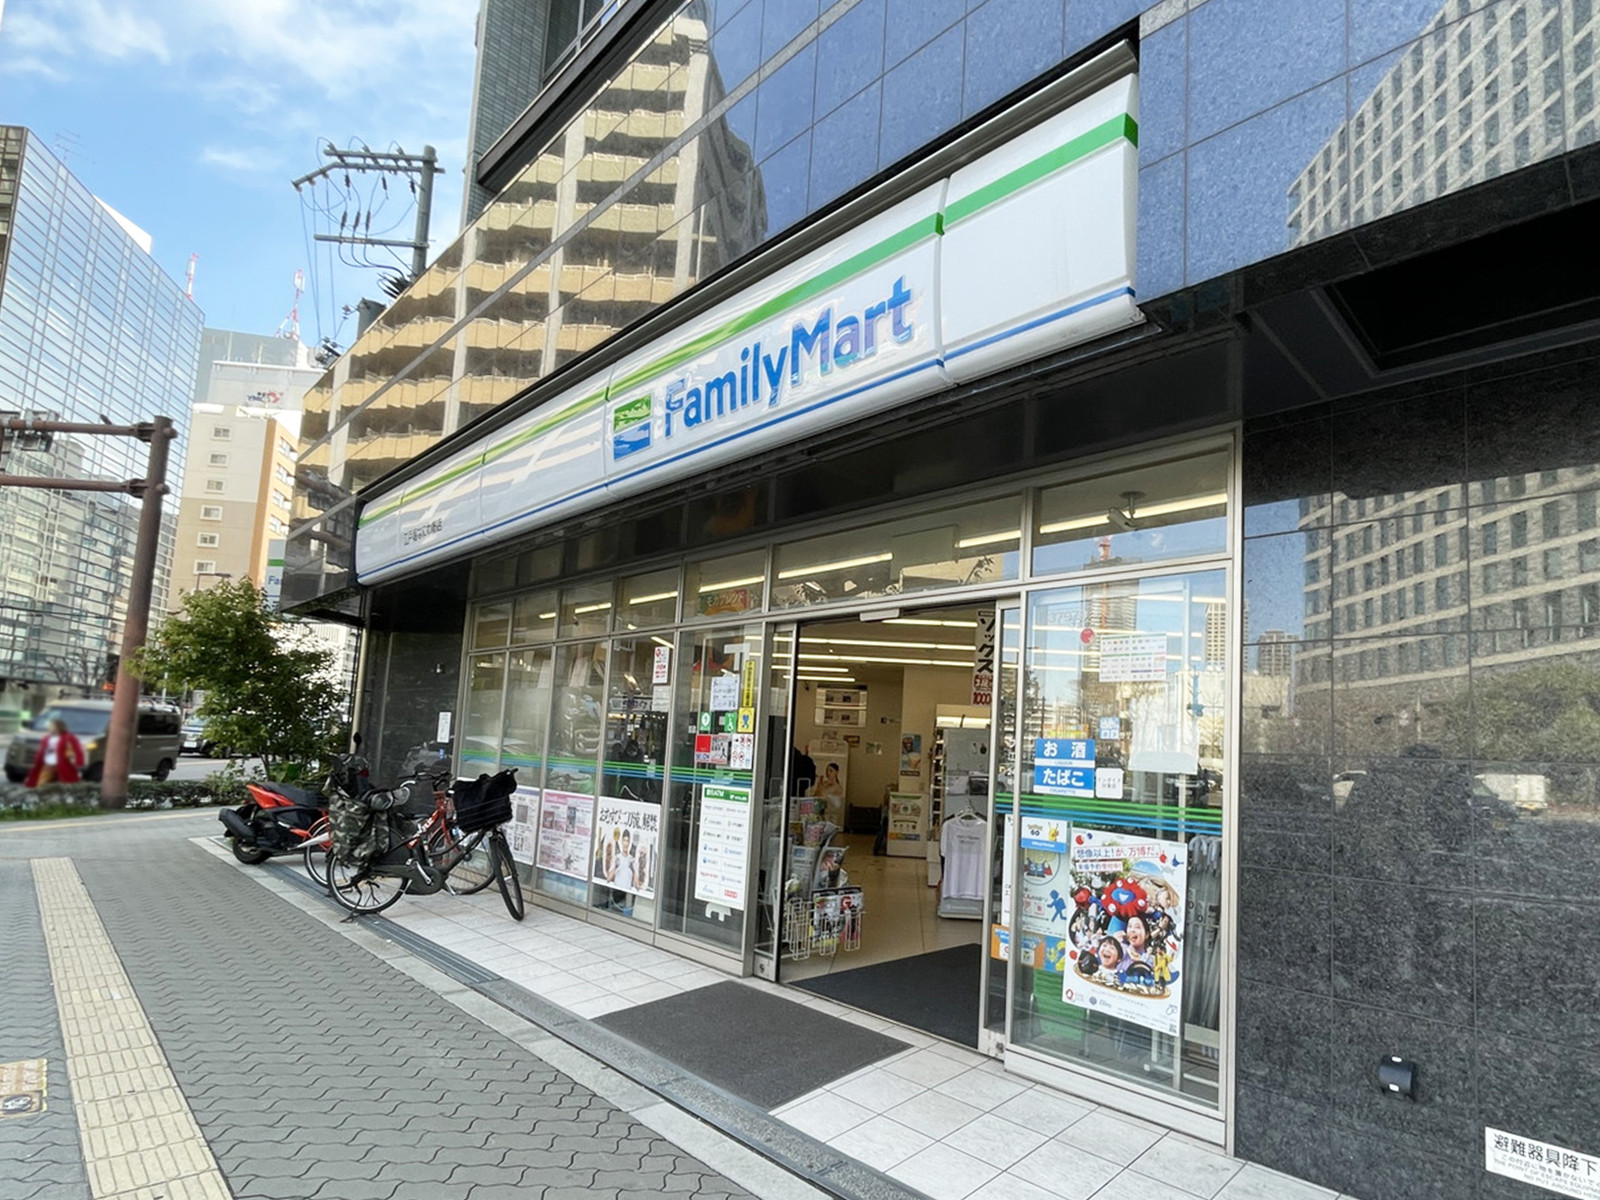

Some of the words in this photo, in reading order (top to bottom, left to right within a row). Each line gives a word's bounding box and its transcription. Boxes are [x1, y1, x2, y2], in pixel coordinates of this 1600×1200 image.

[664, 275, 911, 438] FamilyMart
[1043, 740, 1086, 759] お酒
[1043, 767, 1084, 787] たばこ
[1494, 1133, 1597, 1176] 避難器具降下
[1508, 1162, 1528, 1173] POINT
[1541, 1172, 1568, 1185] ESCAPE
[1552, 1182, 1581, 1196] AROUND
